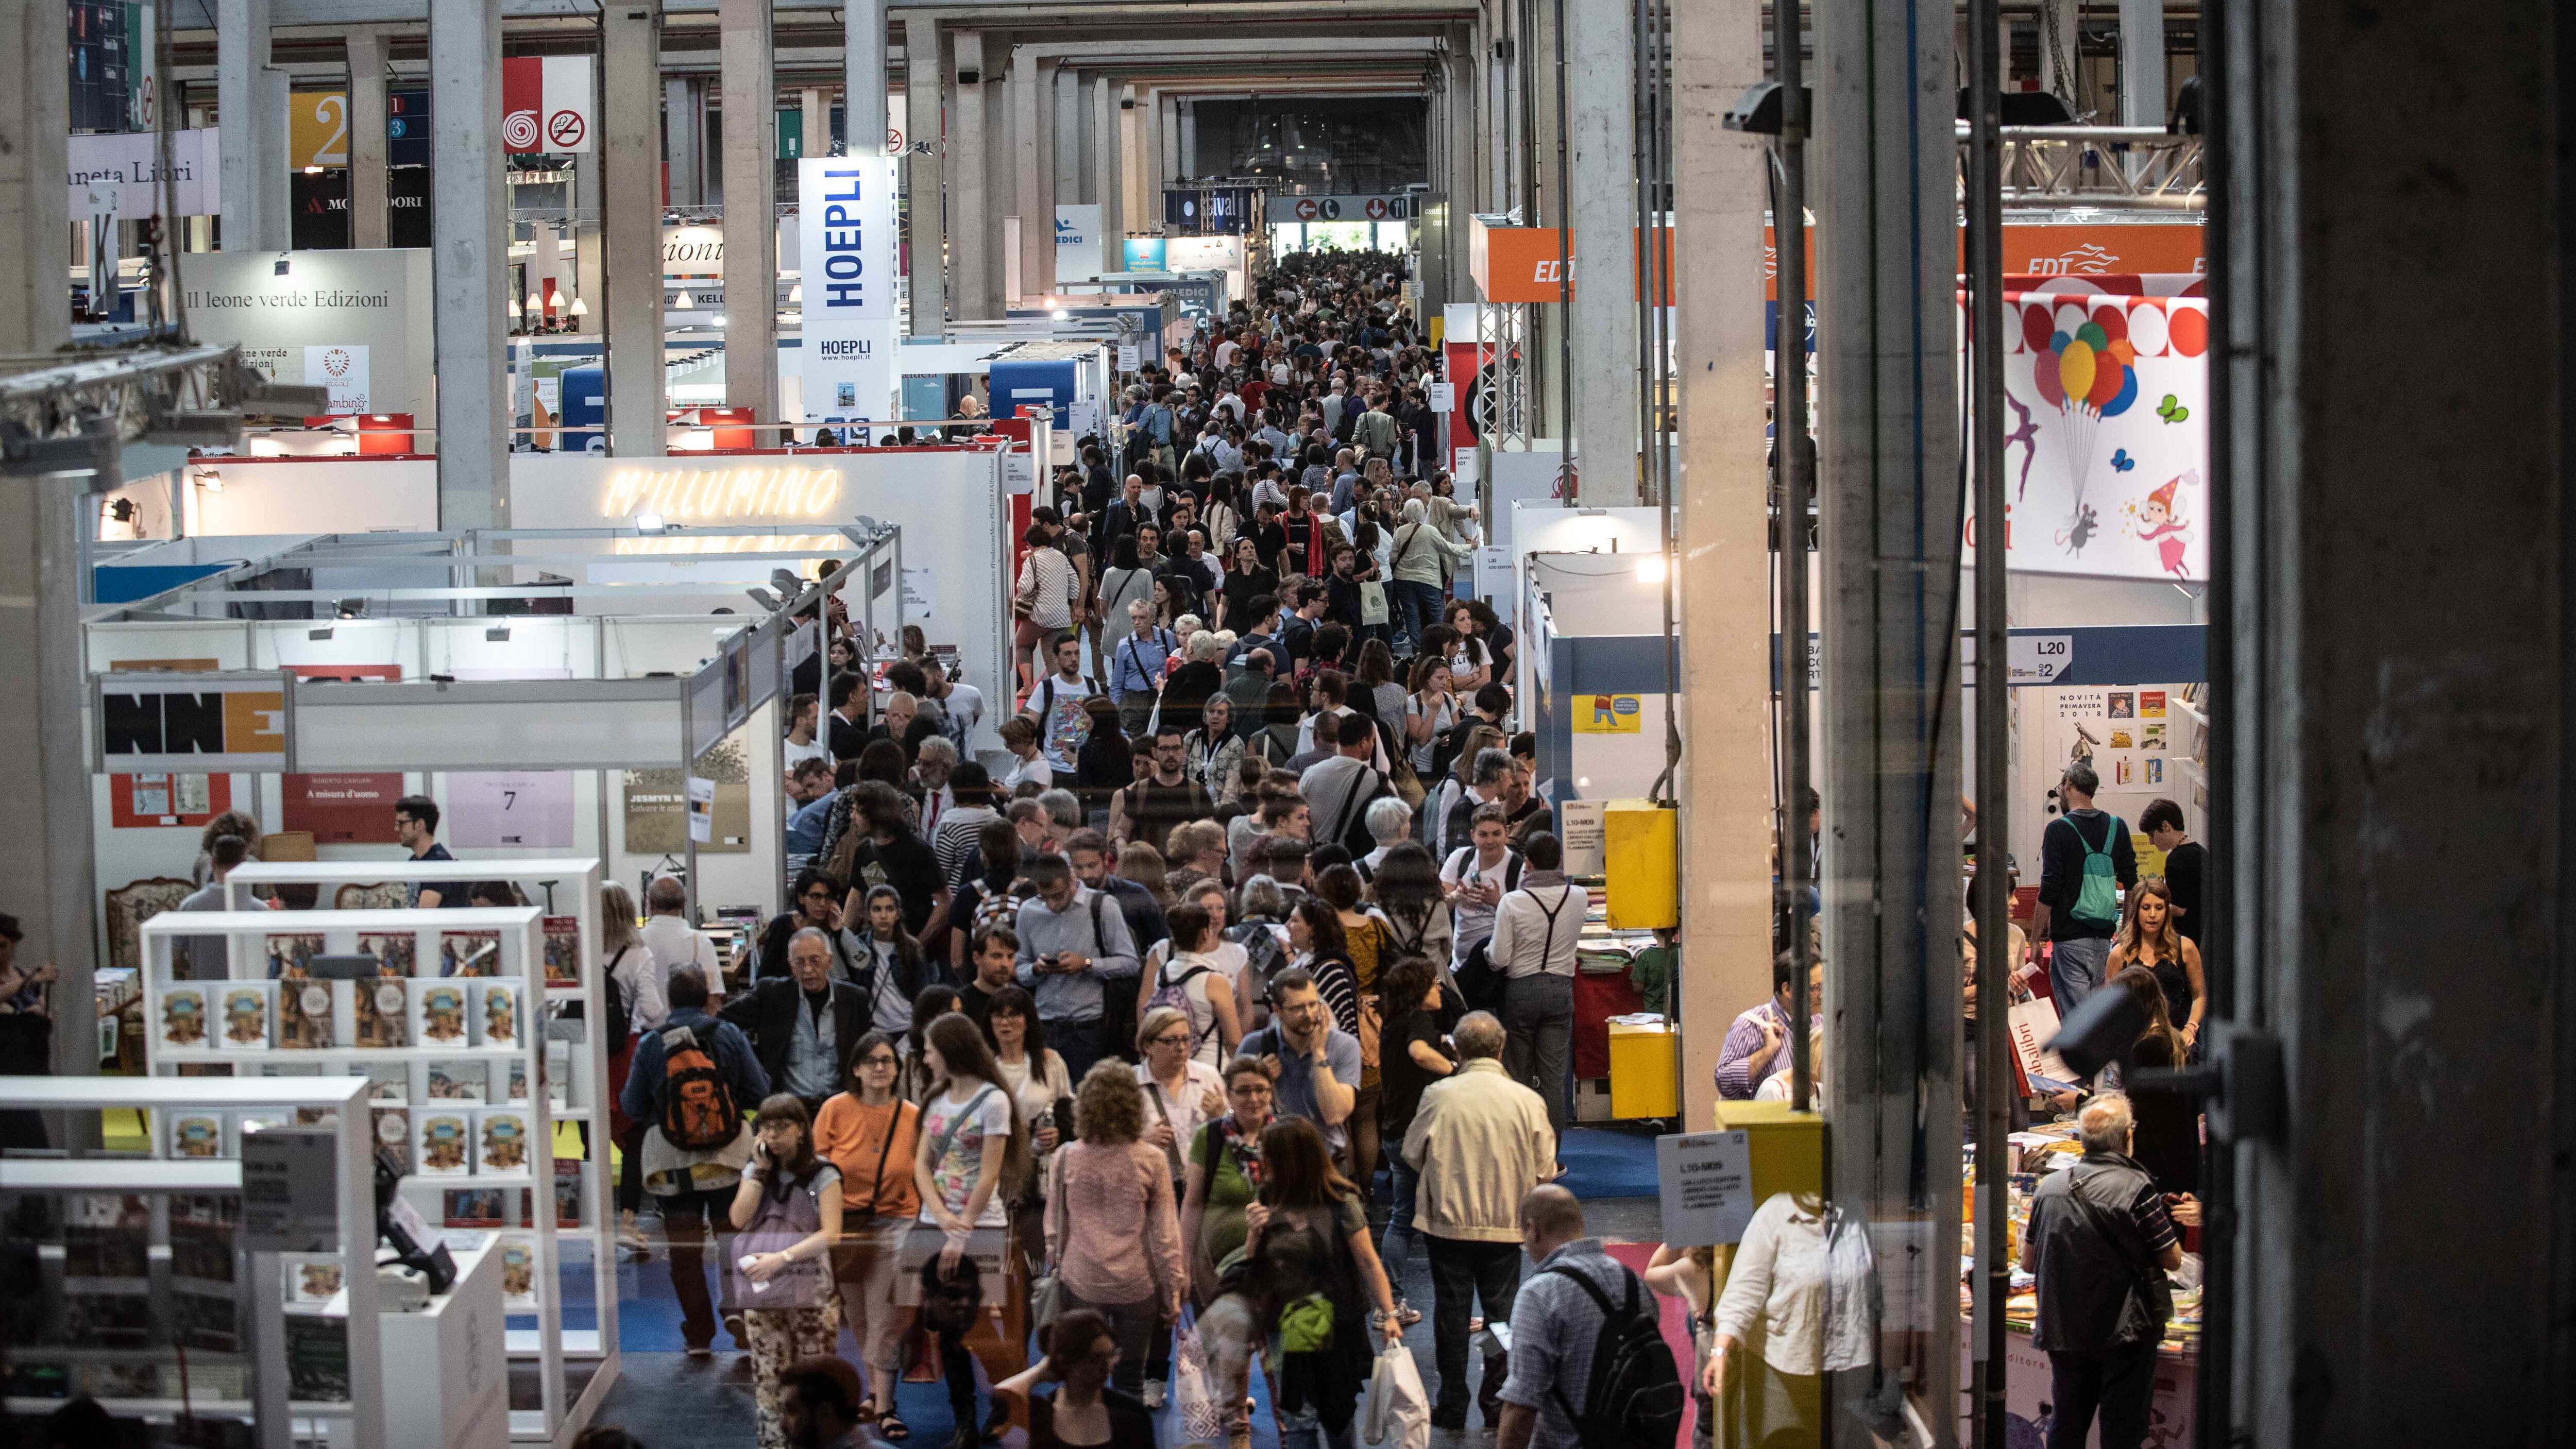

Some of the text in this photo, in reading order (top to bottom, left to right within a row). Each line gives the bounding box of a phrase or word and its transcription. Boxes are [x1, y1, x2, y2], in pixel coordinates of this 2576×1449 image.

[392, 98, 399, 112] 1
[313, 96, 347, 164] 2
[392, 121, 401, 135] 3
[824, 170, 862, 306] HOEPLI
[663, 235, 723, 263] ioni
[187, 290, 389, 308] Il leone verde Edizioni
[698, 295, 724, 303] KELL
[261, 348, 287, 357] verde
[821, 340, 871, 354] HOEPLI
[328, 394, 365, 408] ambino
[2038, 642, 2065, 655] L20
[2044, 664, 2053, 676] 2
[2060, 693, 2101, 701] NOVITÀ
[306, 789, 380, 798] A misura d'uomo
[630, 794, 671, 803] JESMYN
[504, 791, 516, 811] 7
[2015, 1023, 2044, 1077] abalibri
